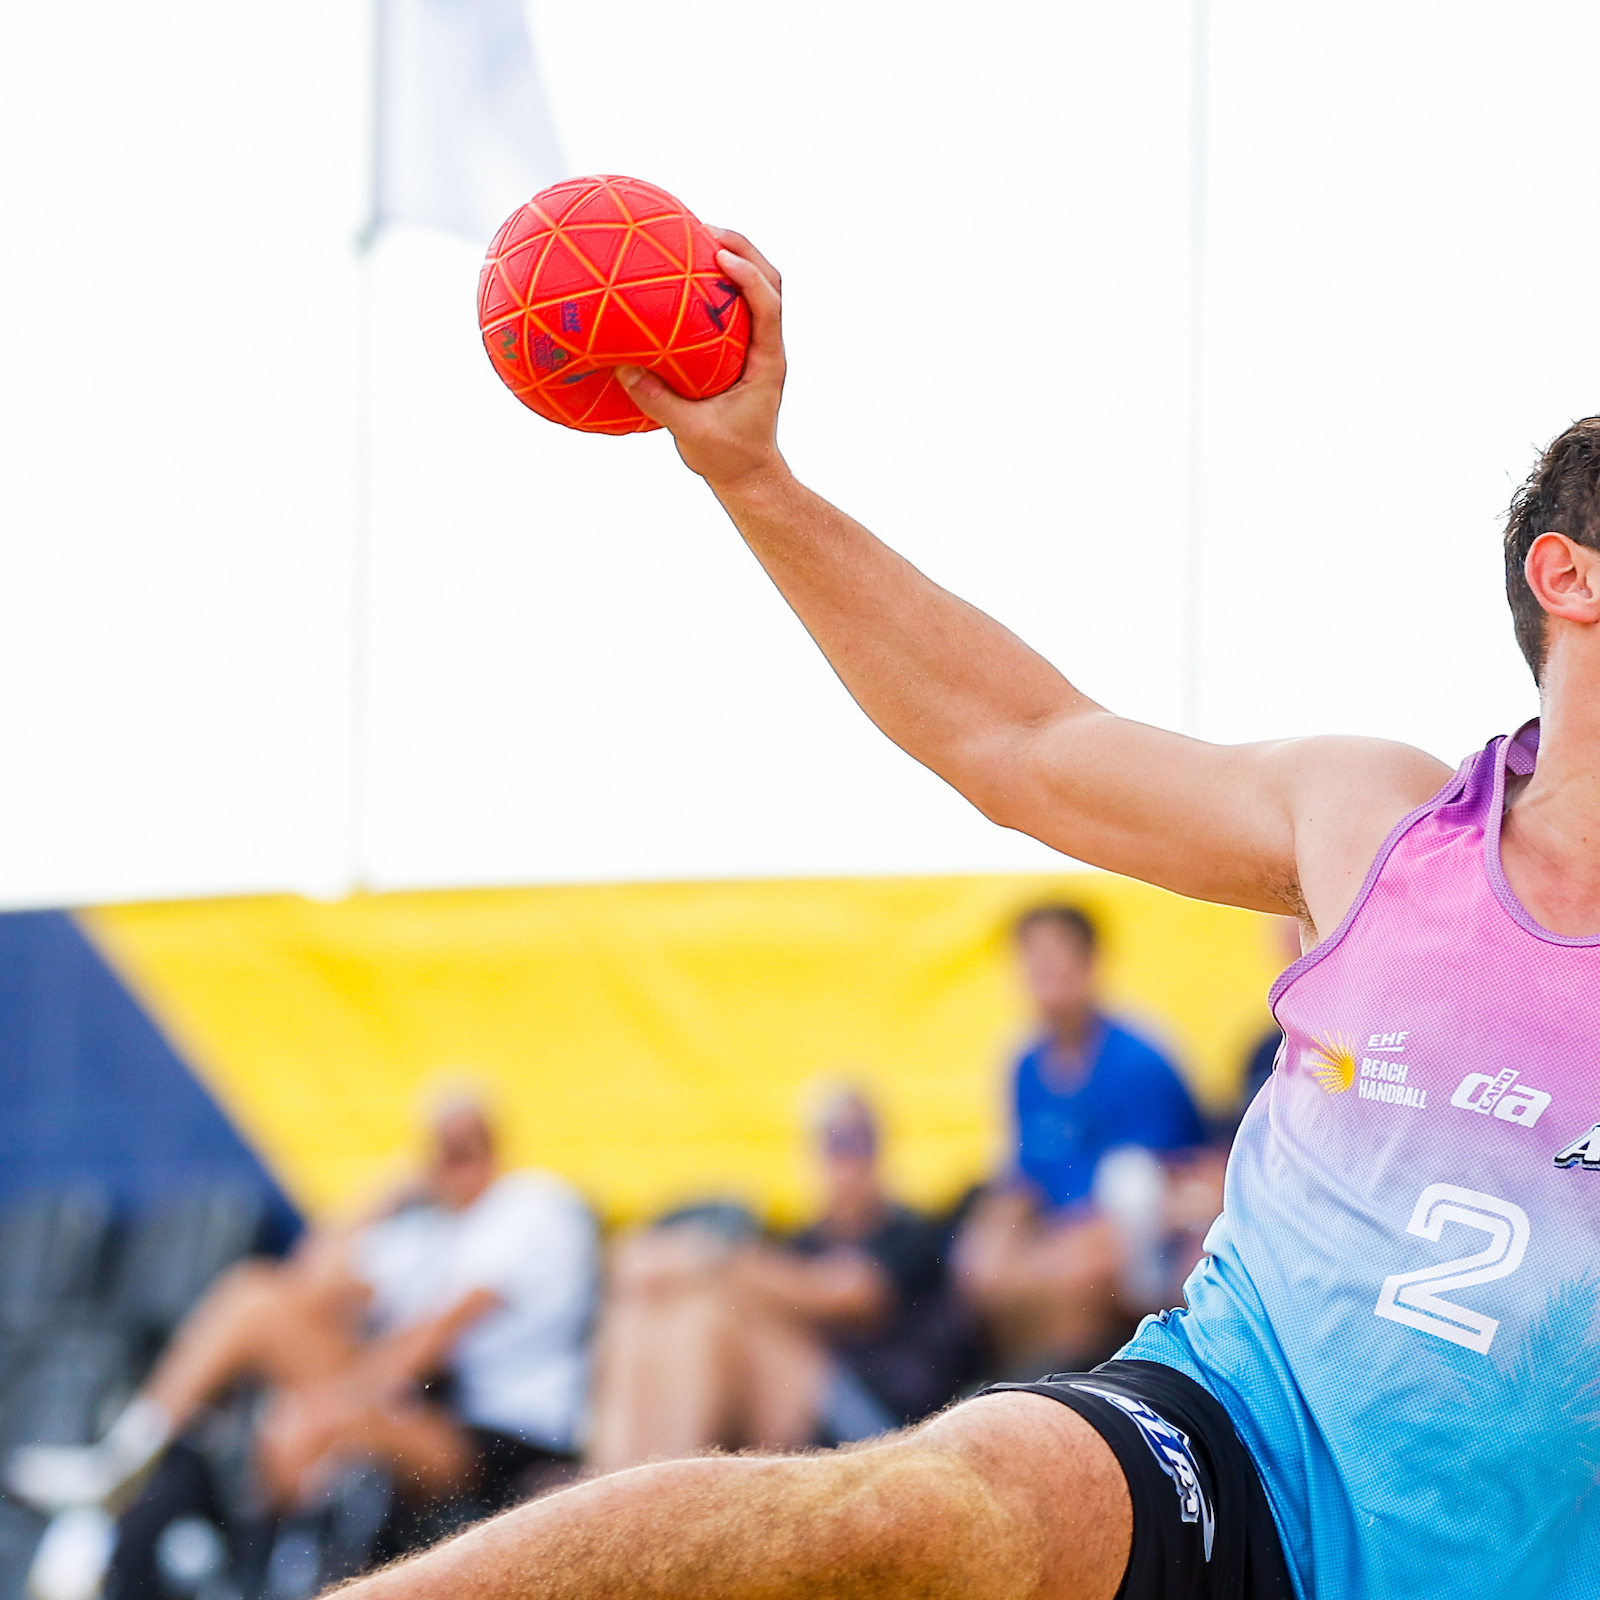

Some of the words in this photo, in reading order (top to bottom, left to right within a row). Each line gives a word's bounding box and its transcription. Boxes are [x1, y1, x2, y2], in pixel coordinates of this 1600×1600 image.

[1366, 1030, 1411, 1048] EHF
[1360, 1056, 1410, 1084] BEACH
[1357, 1078, 1428, 1111] HANDBALL
[1373, 1182, 1531, 1356] 2
